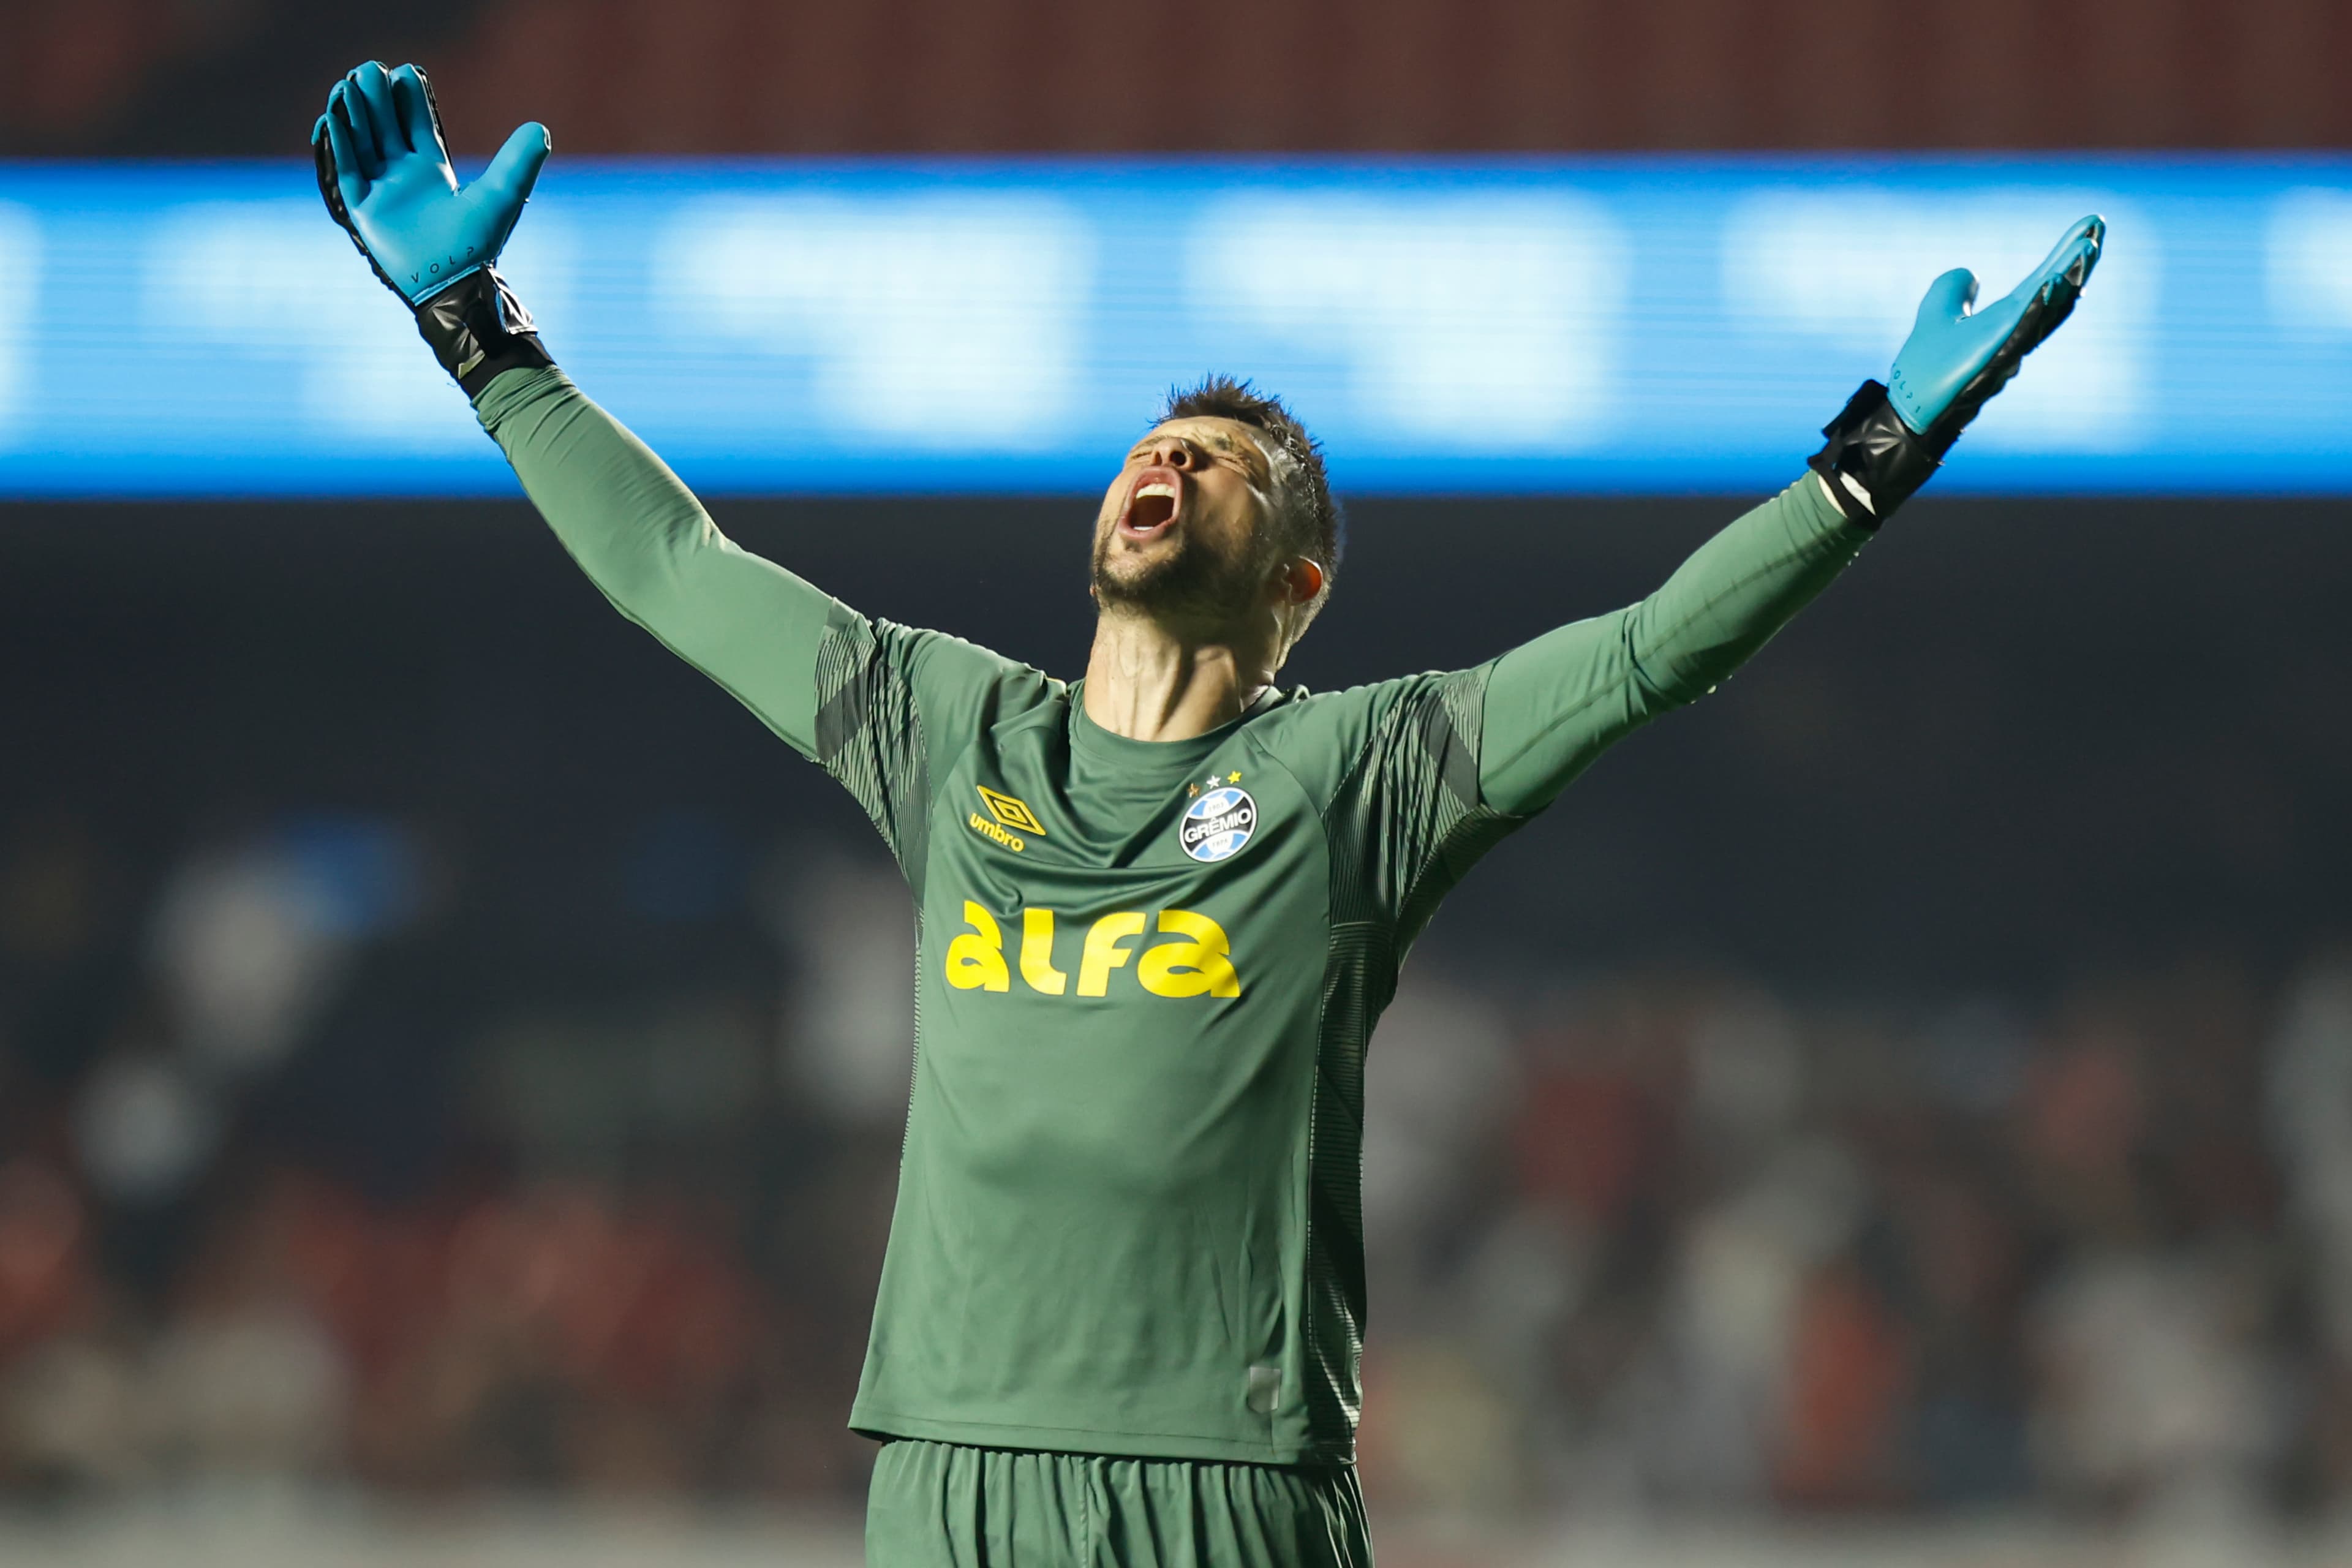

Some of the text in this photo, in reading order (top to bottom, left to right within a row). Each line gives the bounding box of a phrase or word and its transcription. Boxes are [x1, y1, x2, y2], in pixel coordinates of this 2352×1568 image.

[970, 812, 1025, 852] umbro
[1184, 807, 1252, 843] GRÊMIO
[944, 900, 1241, 998] alfa
